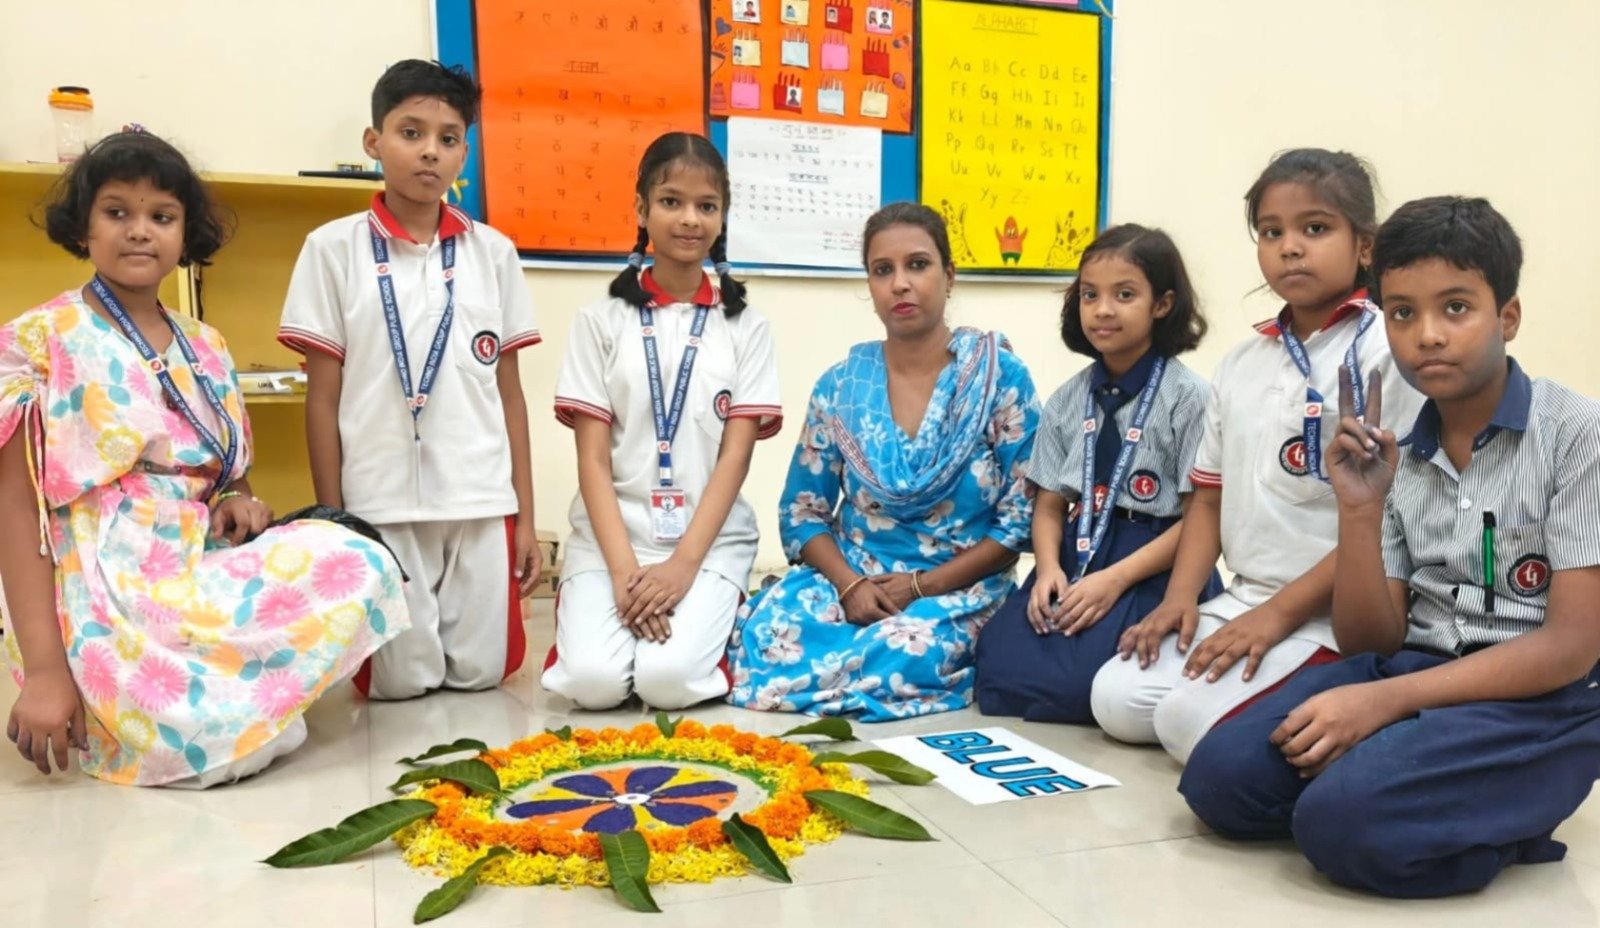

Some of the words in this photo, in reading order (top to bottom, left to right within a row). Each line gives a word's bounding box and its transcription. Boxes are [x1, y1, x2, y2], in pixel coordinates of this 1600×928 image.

[976, 13, 1038, 32] ALPHABET
[950, 56, 971, 72] Aa
[1008, 61, 1026, 77] Cc
[1040, 65, 1059, 80] Dd
[1073, 67, 1087, 82] Ee
[952, 81, 967, 97] Ff
[980, 85, 998, 105] Gg
[1013, 89, 1031, 103] Hh
[949, 109, 963, 124] Kk
[1016, 115, 1032, 129] Mm
[1044, 118, 1062, 132] Nn
[947, 134, 960, 151] Pp
[1011, 139, 1024, 153] Rr
[1064, 143, 1078, 159] Tt
[951, 161, 968, 175] Uu
[987, 164, 1000, 178] Vv
[1023, 167, 1046, 181] Ww
[1065, 171, 1080, 184] Xx
[982, 188, 998, 207] Yy
[445, 246, 453, 266] TECHNO
[382, 279, 392, 304] SCHOOL
[104, 297, 122, 317] GROUP
[387, 305, 397, 328] PUBLIC
[119, 316, 133, 332] INDIA
[131, 332, 150, 356] TECHNO
[391, 329, 402, 350] GROUP
[646, 340, 654, 359] SCHOOL
[397, 351, 405, 368] INDIA
[421, 366, 434, 389] TECHNO
[429, 350, 439, 366] INDIA
[434, 329, 445, 350] GROUP
[649, 360, 657, 379] PUBLIC
[162, 376, 180, 401] SCHOOL
[401, 369, 410, 393] TECHNO
[652, 380, 660, 399] GROUP
[674, 391, 683, 410] GROUP
[679, 371, 688, 390] PUBLIC
[684, 349, 694, 369] SCHOOL
[203, 380, 218, 403] SCHOOL
[1135, 403, 1148, 425] TECHNO
[1144, 387, 1154, 402] INDIA
[1150, 367, 1161, 387] GROUP
[657, 416, 665, 437] TECHNO
[1308, 422, 1316, 451] TECHNO
[1099, 510, 1108, 525] INDIA
[1104, 488, 1115, 509] GROUP
[1111, 467, 1123, 488] PUBLIC
[1118, 445, 1133, 466] SCHOOL
[1080, 514, 1089, 535] TECHNO
[917, 731, 1089, 797] BLUE
